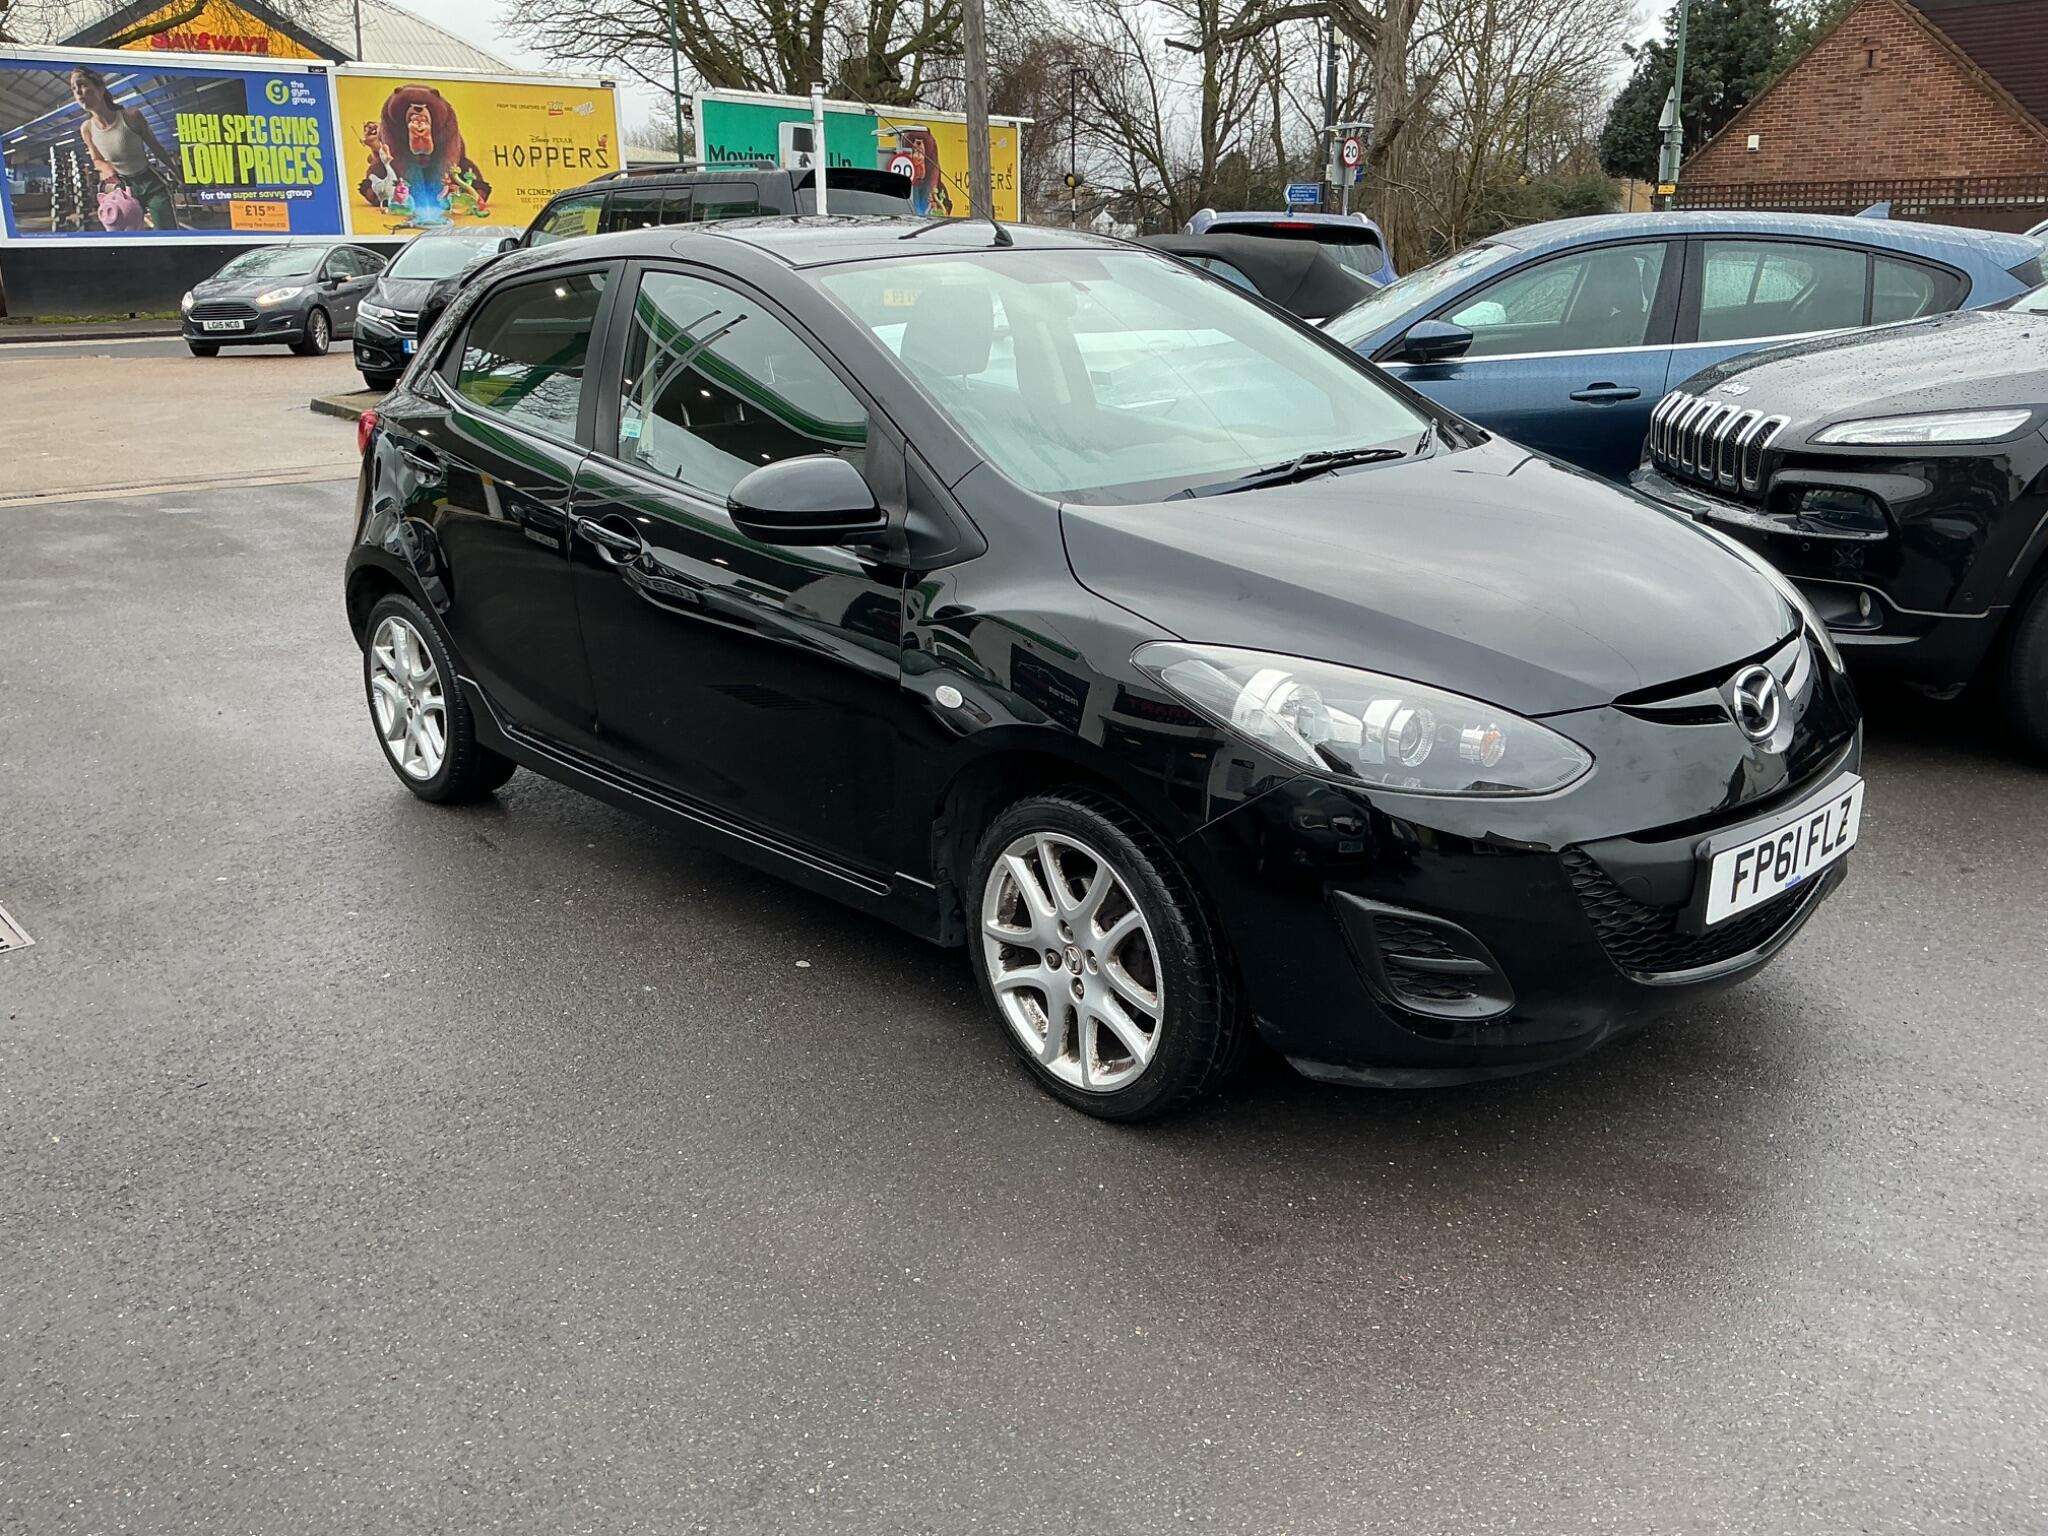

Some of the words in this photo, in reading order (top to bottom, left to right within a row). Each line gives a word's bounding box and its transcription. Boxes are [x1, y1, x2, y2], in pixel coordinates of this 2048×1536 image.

[291, 89, 309, 97] gym
[292, 97, 316, 106] group
[176, 113, 221, 142] HIGH
[222, 114, 268, 144] SPEC
[269, 116, 320, 145] GYMS
[494, 145, 610, 168] HOPPERS
[1345, 146, 1358, 158] 20
[180, 143, 235, 184] LOW
[237, 144, 324, 185] PRICES
[200, 191, 215, 200] for
[216, 191, 231, 199] the
[233, 191, 257, 200] super
[258, 190, 285, 199] savvy
[286, 189, 313, 198] group
[1730, 825, 1802, 904] FP61
[1804, 795, 1853, 867] FLZ
